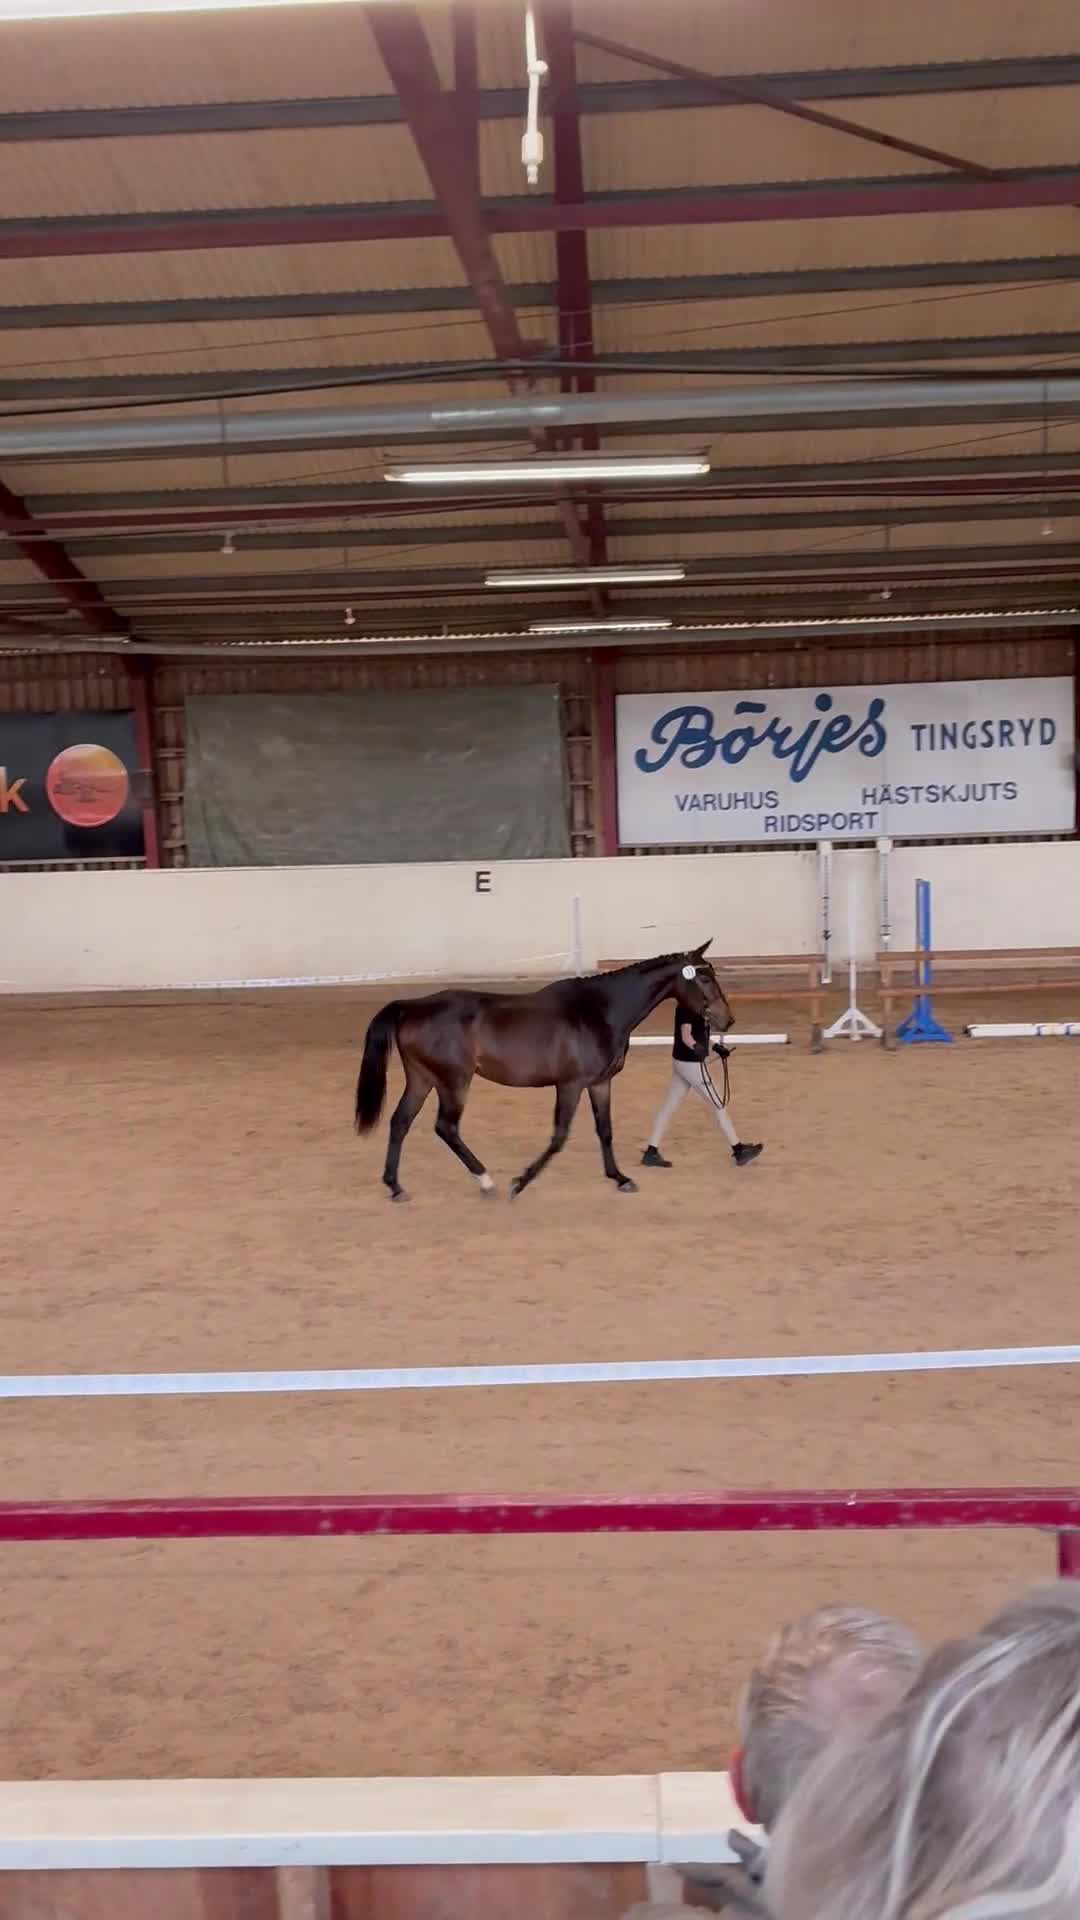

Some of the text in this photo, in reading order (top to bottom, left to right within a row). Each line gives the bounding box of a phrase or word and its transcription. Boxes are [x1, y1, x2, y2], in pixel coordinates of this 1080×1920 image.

[911, 718, 1056, 752] TINGSRYD
[675, 790, 780, 812] VARUHUS
[861, 781, 1018, 806] HÄSTSKJUTS
[764, 811, 879, 833] RIDSPORT
[475, 871, 491, 892] E
